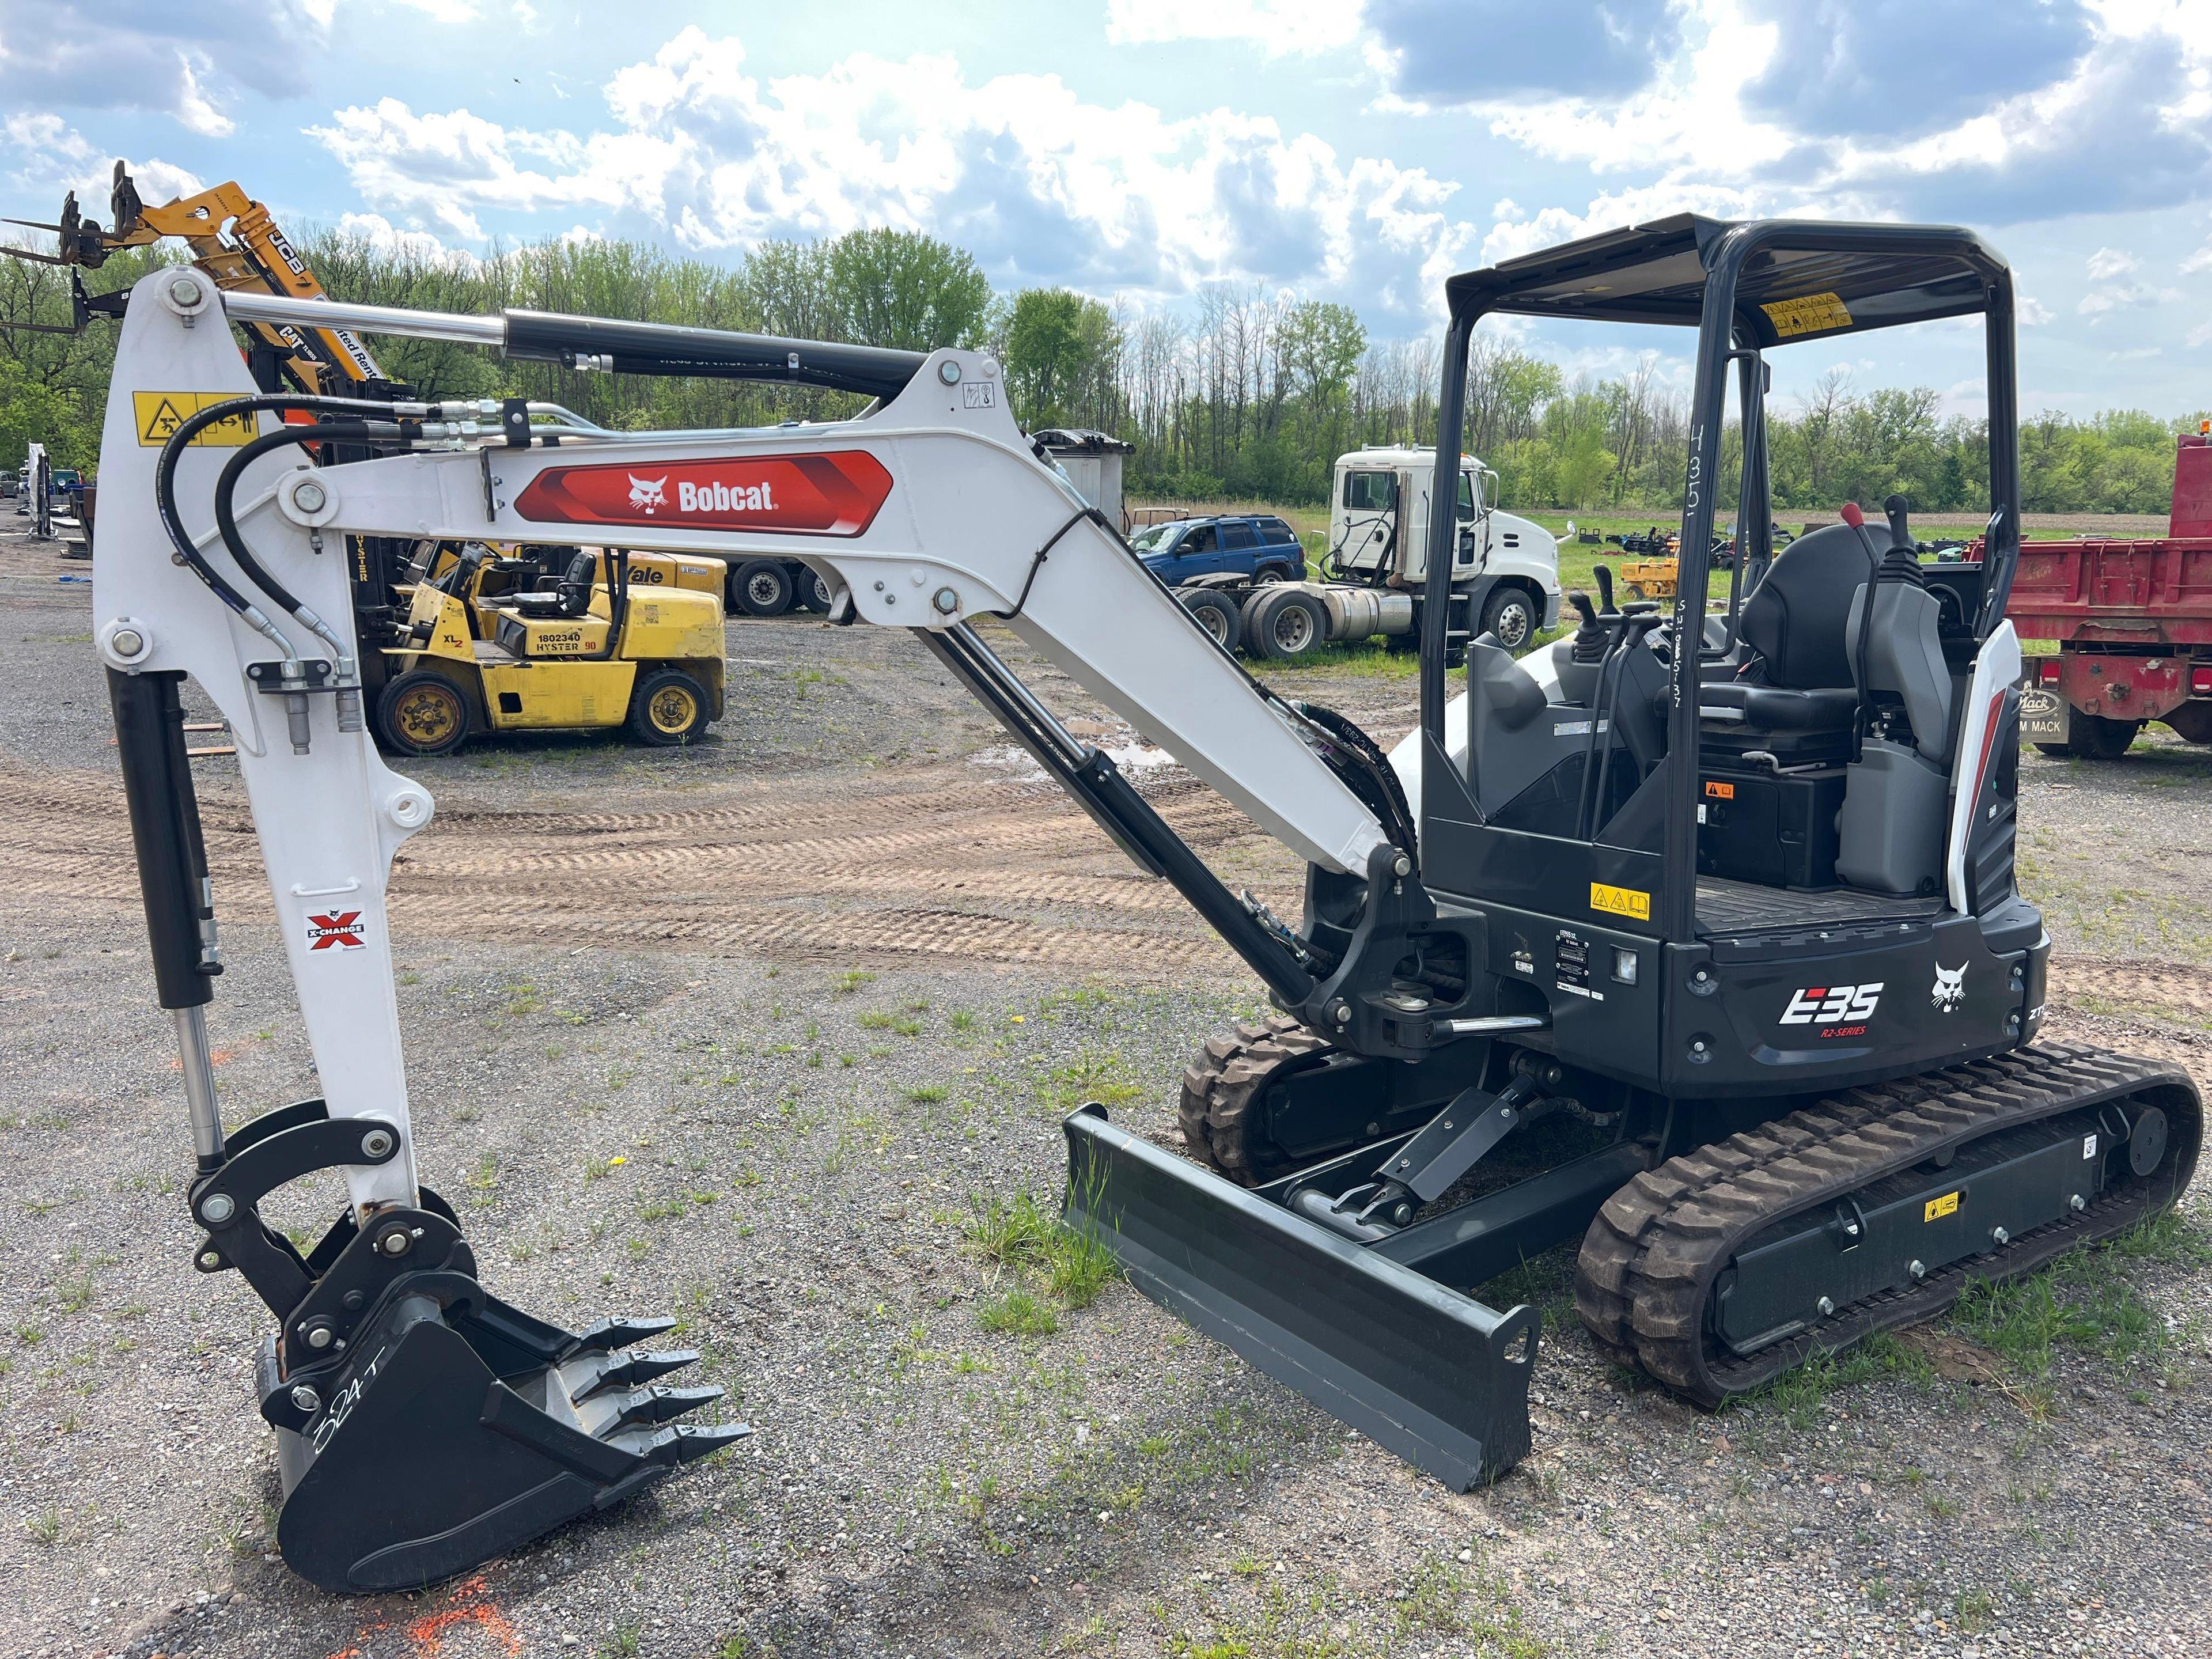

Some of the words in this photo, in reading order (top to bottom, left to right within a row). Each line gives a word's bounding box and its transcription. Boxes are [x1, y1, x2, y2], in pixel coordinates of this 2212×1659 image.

[268, 232, 306, 275] JCB
[279, 326, 304, 349] CAT
[337, 329, 359, 351] ited
[354, 353, 378, 378] Rent
[679, 482, 772, 512] Bobcat
[537, 643, 578, 651] HYSTER
[585, 642, 596, 650] 90
[538, 634, 581, 642] 1802340
[2019, 721, 2027, 732] M
[2032, 721, 2061, 732] MACK
[309, 925, 362, 938] X-CHANGE
[1778, 982, 1884, 1024] E35
[1820, 1025, 1867, 1038] R2-SERIES
